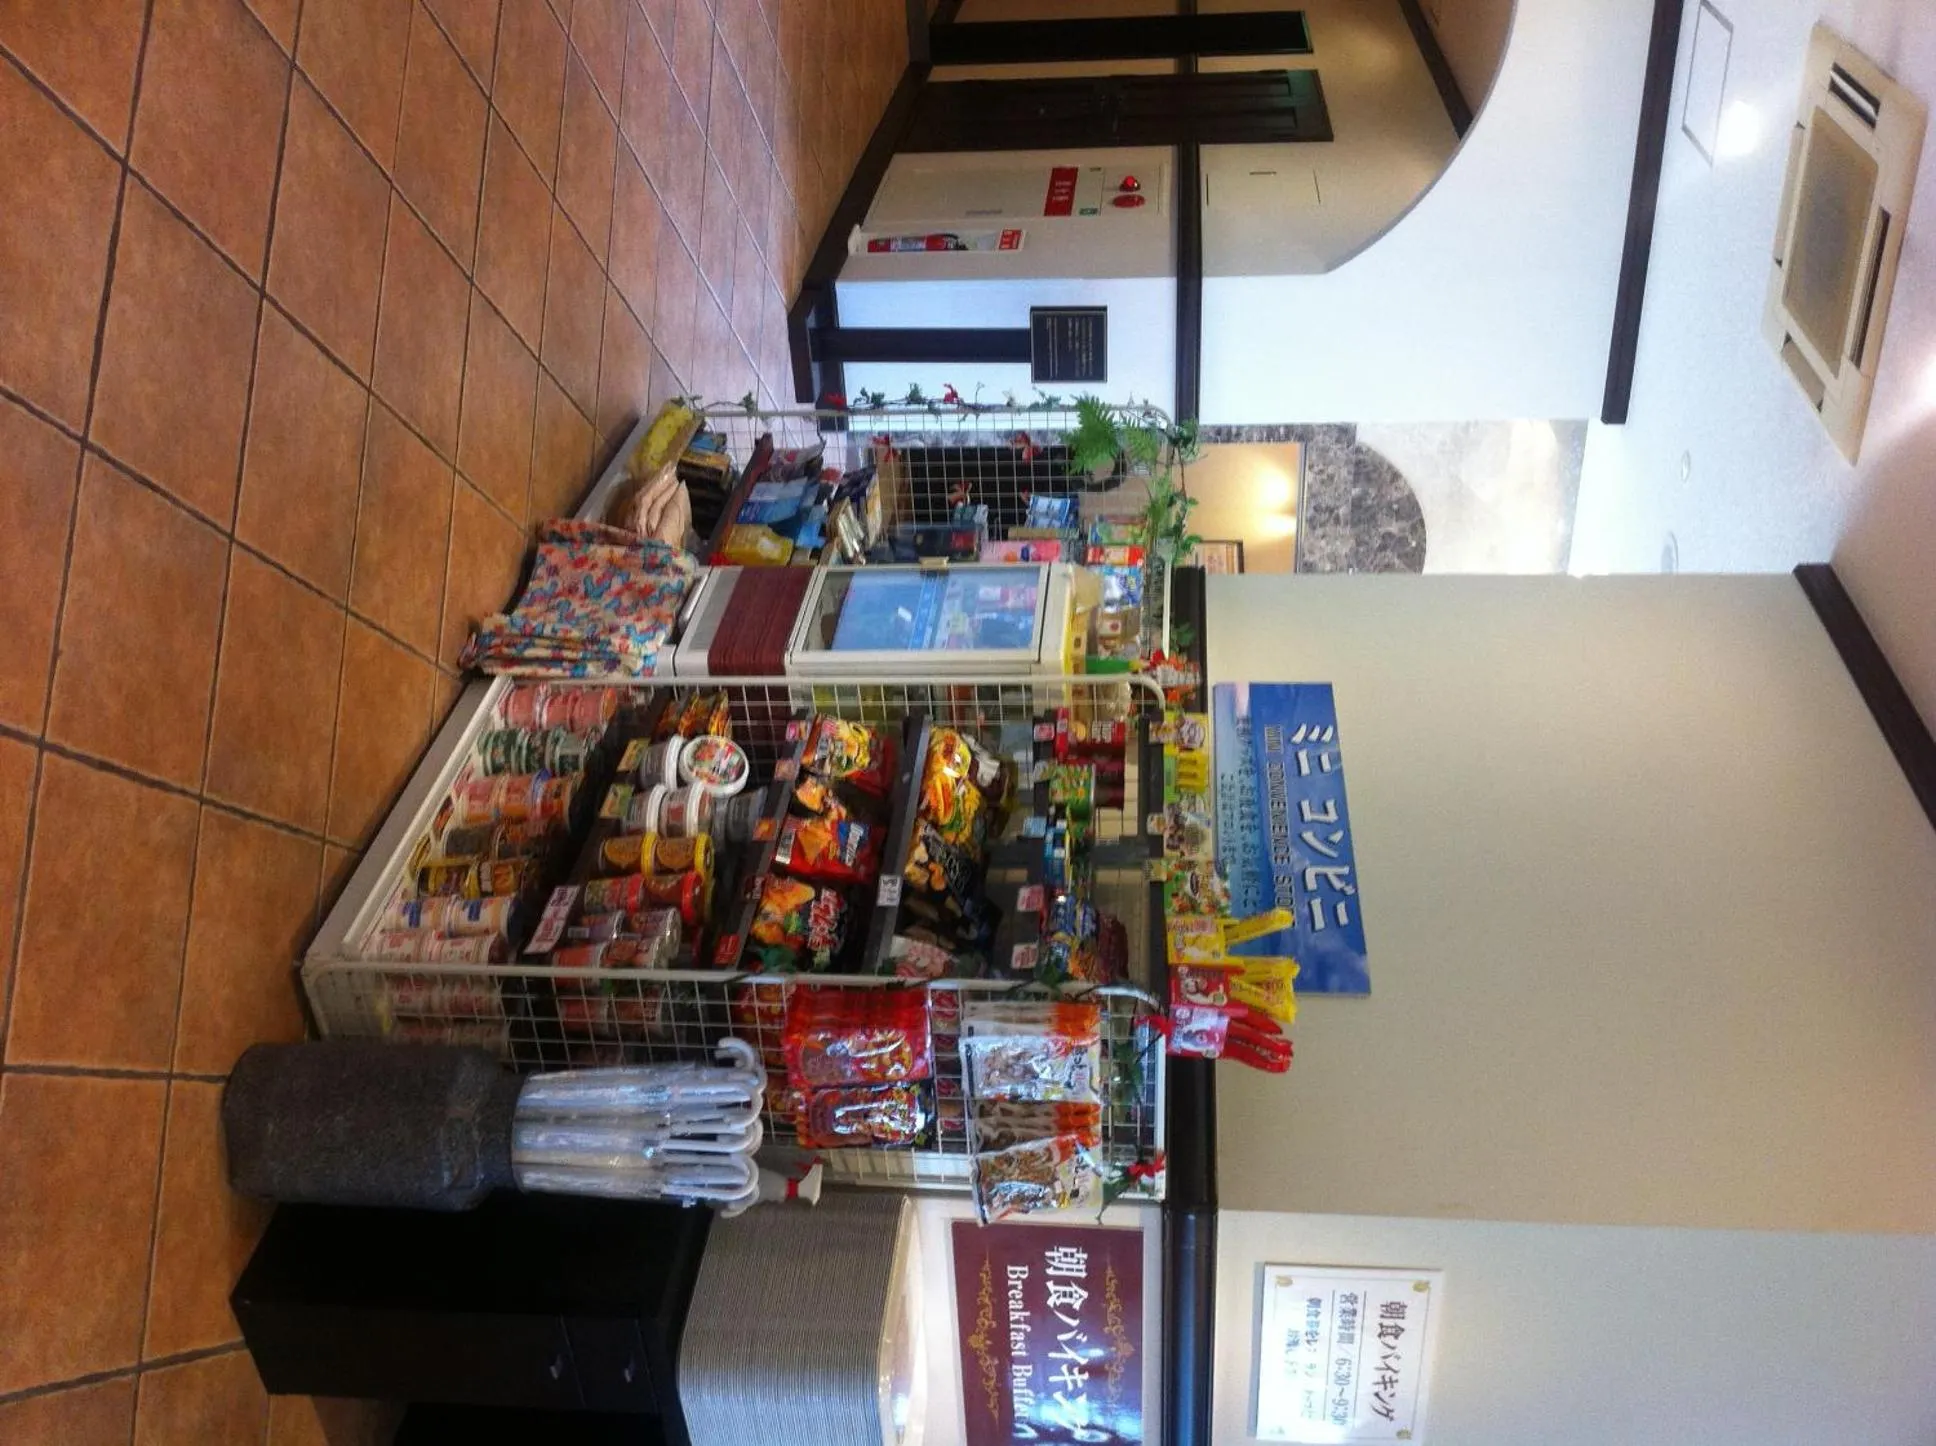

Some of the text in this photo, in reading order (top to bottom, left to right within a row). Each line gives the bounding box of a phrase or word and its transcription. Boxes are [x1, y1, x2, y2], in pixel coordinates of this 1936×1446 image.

[1264, 724, 1296, 928] MINI CONVENIENCE STO
[1290, 723, 1355, 932] ミニ コンビニ
[1007, 1265, 1035, 1420] Breakfast Buffet
[1044, 1245, 1090, 1440] 朝食バイキング
[1371, 1301, 1408, 1422] 朝食バイキング
